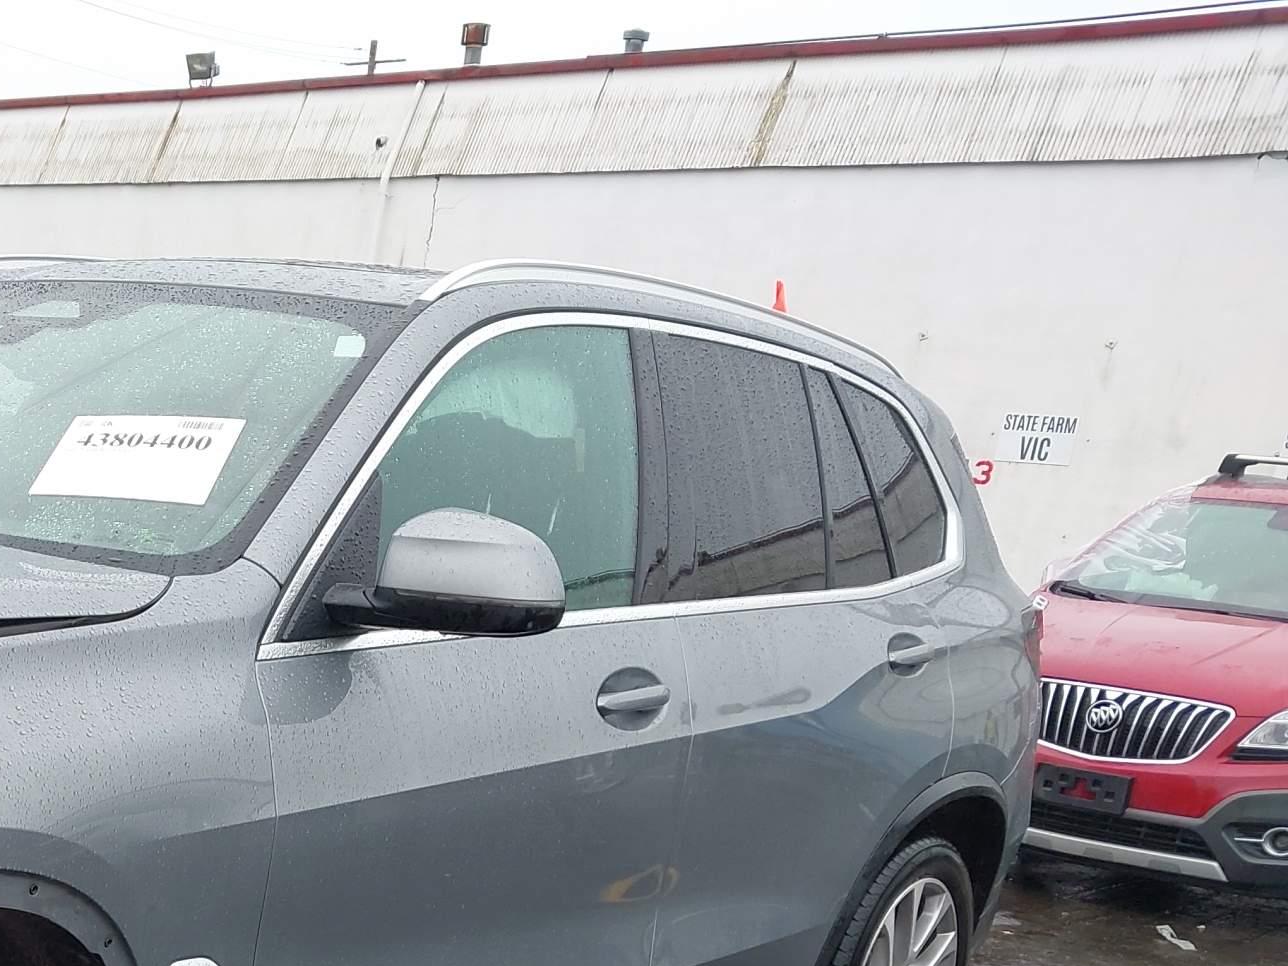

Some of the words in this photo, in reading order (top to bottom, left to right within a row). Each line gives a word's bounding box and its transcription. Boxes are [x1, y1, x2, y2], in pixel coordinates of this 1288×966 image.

[1003, 413, 1040, 432] STATE
[1040, 415, 1078, 434] FARM
[76, 432, 213, 451] 43804400
[1019, 435, 1051, 462] VIC
